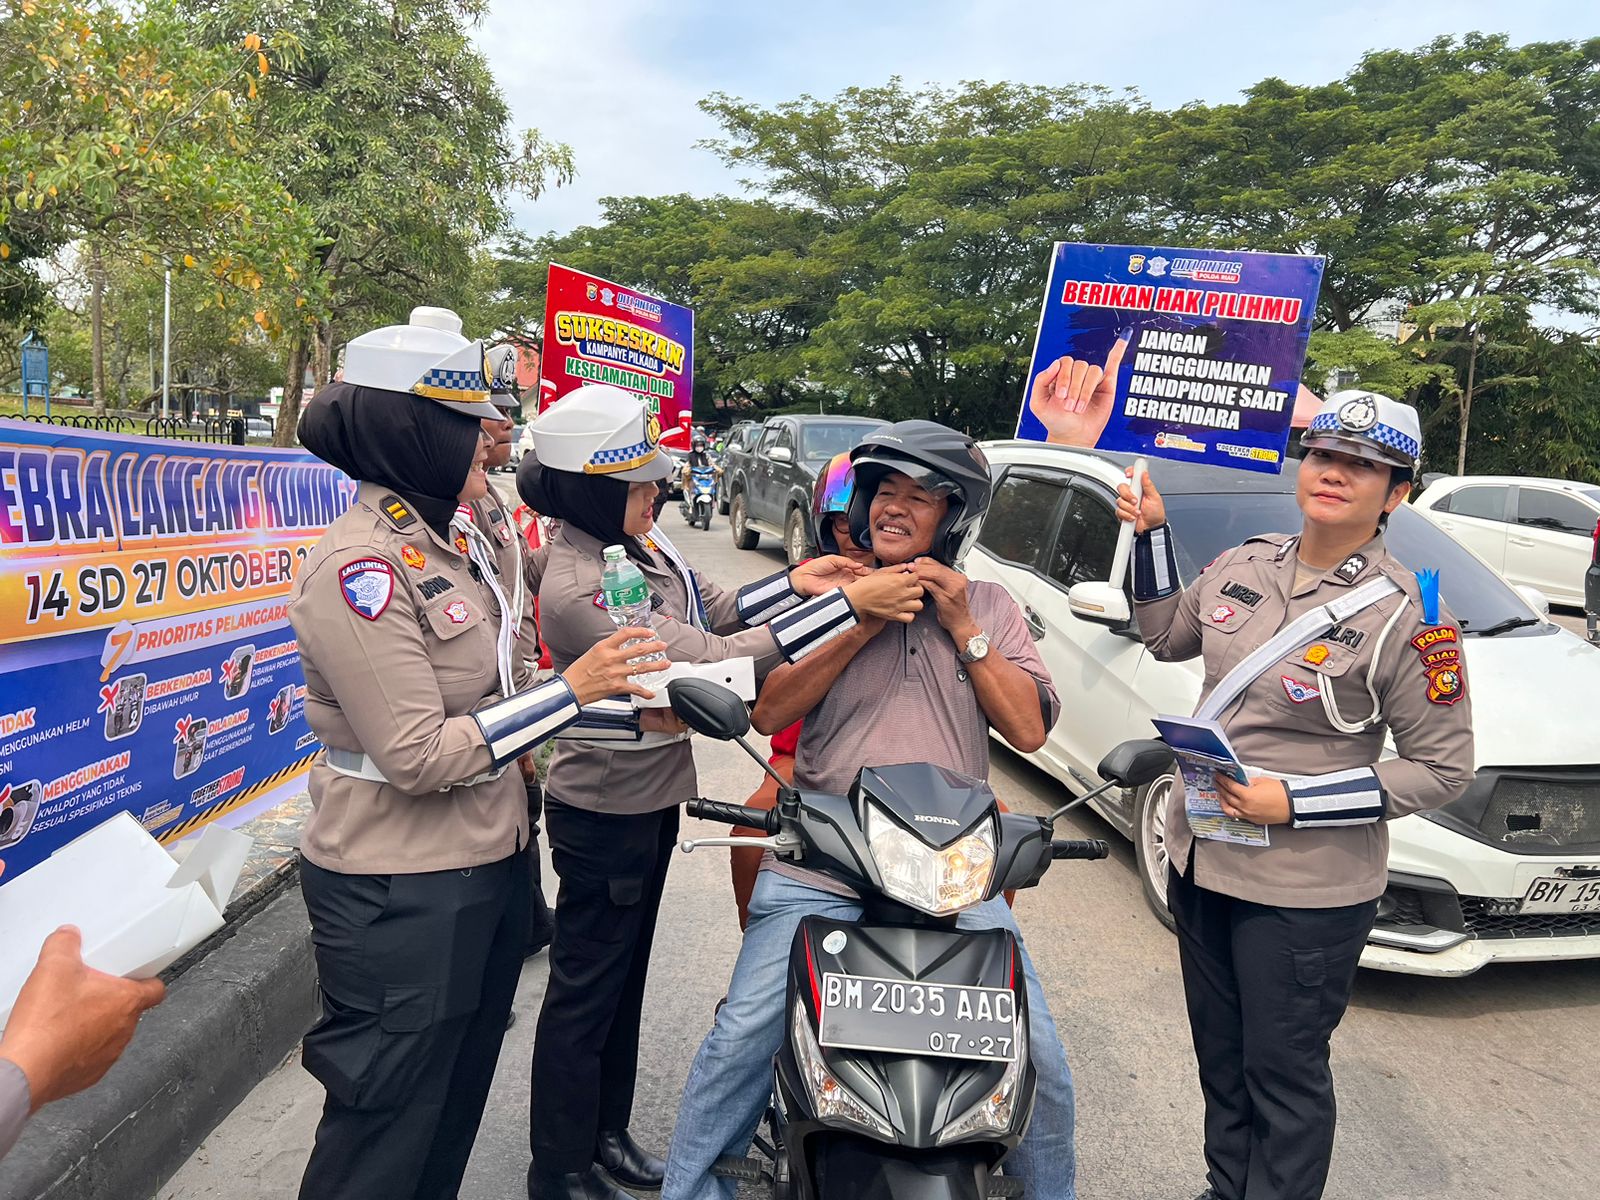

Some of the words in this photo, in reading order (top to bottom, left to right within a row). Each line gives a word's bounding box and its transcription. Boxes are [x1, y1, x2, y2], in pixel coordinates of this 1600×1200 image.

[1171, 258, 1242, 274] DITLANTAS
[1199, 272, 1220, 280] POLDA
[1063, 281, 1153, 311] BERIKAN
[1155, 287, 1201, 315] HAK
[1204, 292, 1302, 324] PILIHMU
[558, 315, 683, 371] SUKSESKAN
[586, 342, 627, 361] KAMPANYE
[628, 350, 658, 371] PILKADA
[1139, 330, 1208, 355] JANGAN
[566, 358, 648, 391] KESELAMATAN
[650, 377, 674, 397] DIRI
[1134, 353, 1272, 386] MENGGUNAKAN
[1129, 375, 1239, 407] HANDPHONE
[1240, 387, 1288, 412] SAAT
[1124, 398, 1240, 430] BERKENDARA
[1251, 449, 1278, 461] STRONG
[116, 456, 261, 540] LANCANG
[263, 466, 349, 527] KUNING
[342, 563, 360, 576] LALU
[361, 561, 388, 571] LINTAS
[27, 573, 69, 620] 14
[80, 567, 125, 612] SD
[134, 561, 167, 604] 27
[177, 550, 292, 596] OKTOBER
[100, 630, 133, 682] 7
[136, 620, 212, 652] PRIORITAS
[255, 642, 298, 662] BERKENDARA
[1417, 630, 1455, 648] POLDA
[1428, 650, 1457, 662] RIAU
[146, 671, 211, 698] BERKENDARA
[144, 696, 179, 716] DIBAWAH
[180, 692, 200, 705] UMUR
[0, 710, 33, 734] IDAK
[66, 717, 91, 734] HELM
[208, 709, 248, 735] DILARANG
[203, 750, 218, 763] SAAT
[218, 734, 252, 756] BERKENDARA
[43, 752, 130, 800] MENGGUNAKAN
[31, 816, 67, 834] SESUAI
[68, 794, 116, 821] SPESIFIKASI
[116, 781, 142, 802] TEKNIS
[37, 795, 80, 820] KNALPOT
[81, 785, 102, 802] YANG
[103, 775, 126, 792] TIDAK
[914, 814, 961, 826] HONDA
[1529, 881, 1568, 902] BM
[1569, 882, 1600, 903] 15
[826, 976, 863, 1009] BM
[871, 983, 945, 1017] 2035
[956, 990, 1013, 1023] AAC
